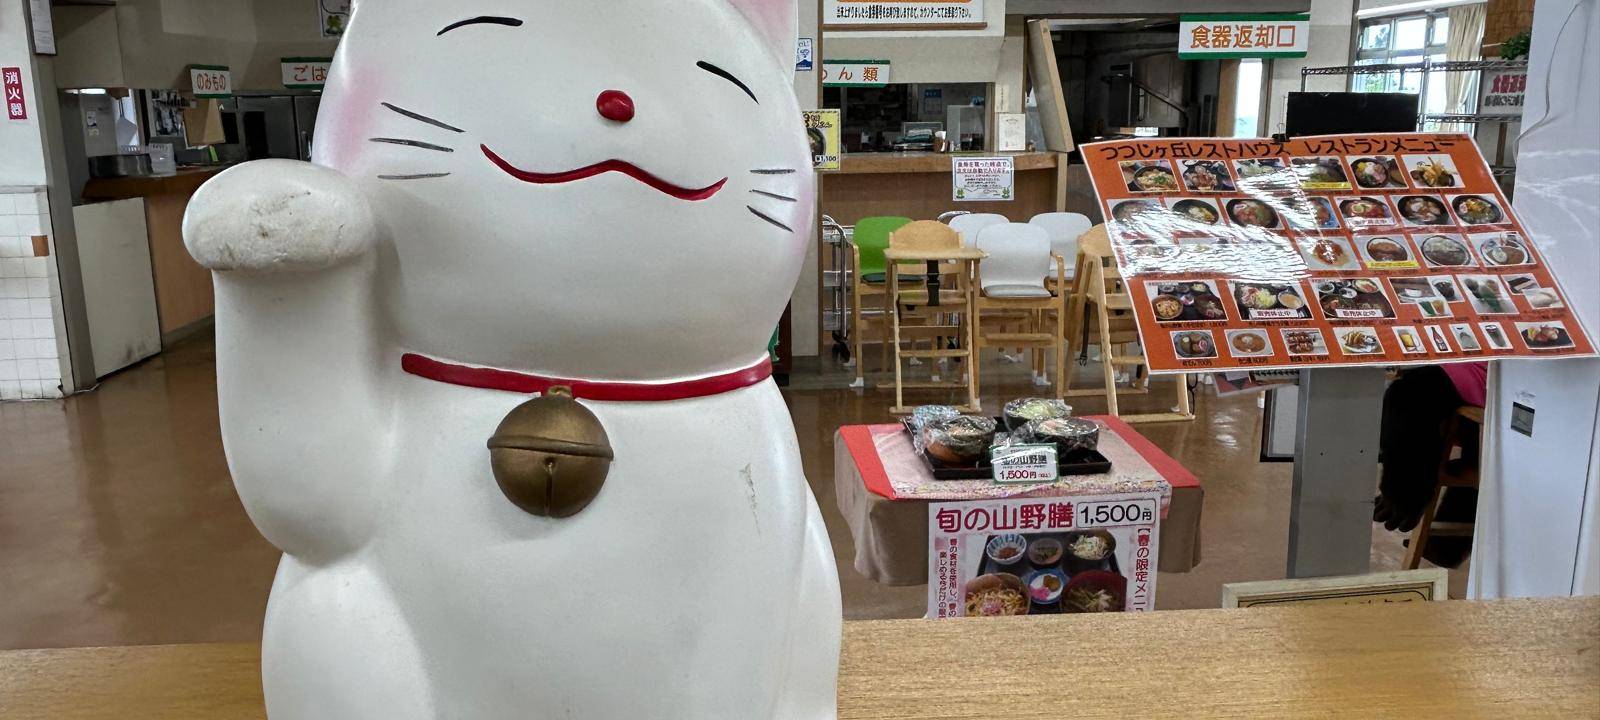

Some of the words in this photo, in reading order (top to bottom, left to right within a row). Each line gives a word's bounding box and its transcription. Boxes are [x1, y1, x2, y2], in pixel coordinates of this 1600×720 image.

[1190, 24, 1296, 48] 食器返却口
[196, 73, 226, 91] のみもの
[6, 71, 23, 116] 消火器
[1304, 137, 1455, 154] レストランメニュー
[1000, 470, 1037, 479] 1,500円
[936, 502, 1074, 533] 旬の山野膳
[1080, 504, 1153, 525] 1,500円
